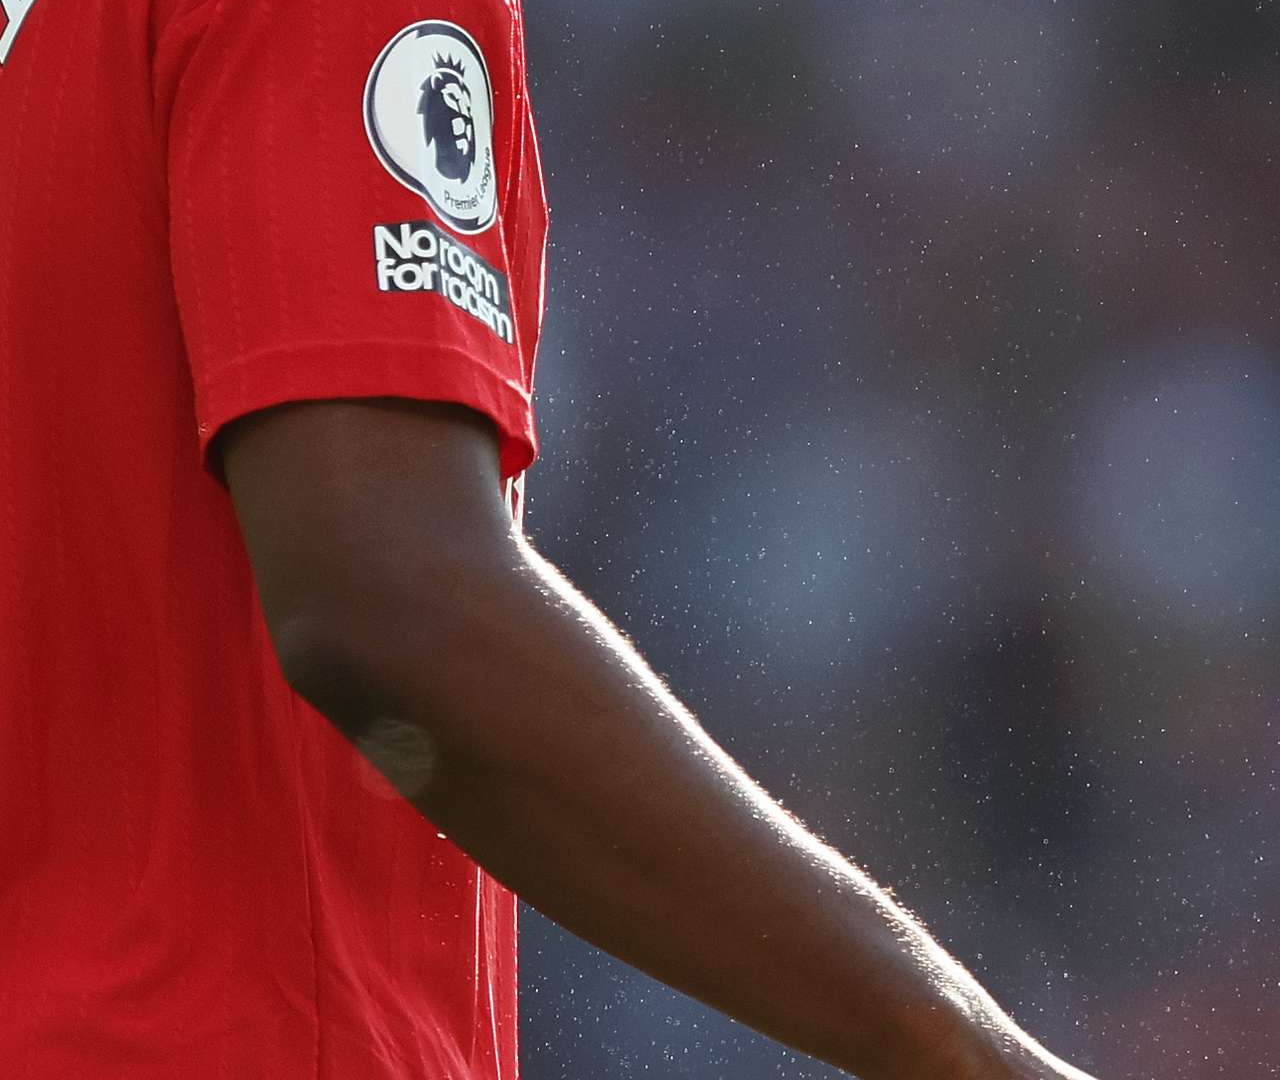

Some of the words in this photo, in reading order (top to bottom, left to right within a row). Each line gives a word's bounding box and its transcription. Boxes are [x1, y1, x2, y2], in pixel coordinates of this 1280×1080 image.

[444, 190, 480, 210] Premier
[374, 223, 438, 260] No
[439, 238, 500, 305] room
[377, 258, 439, 291] for
